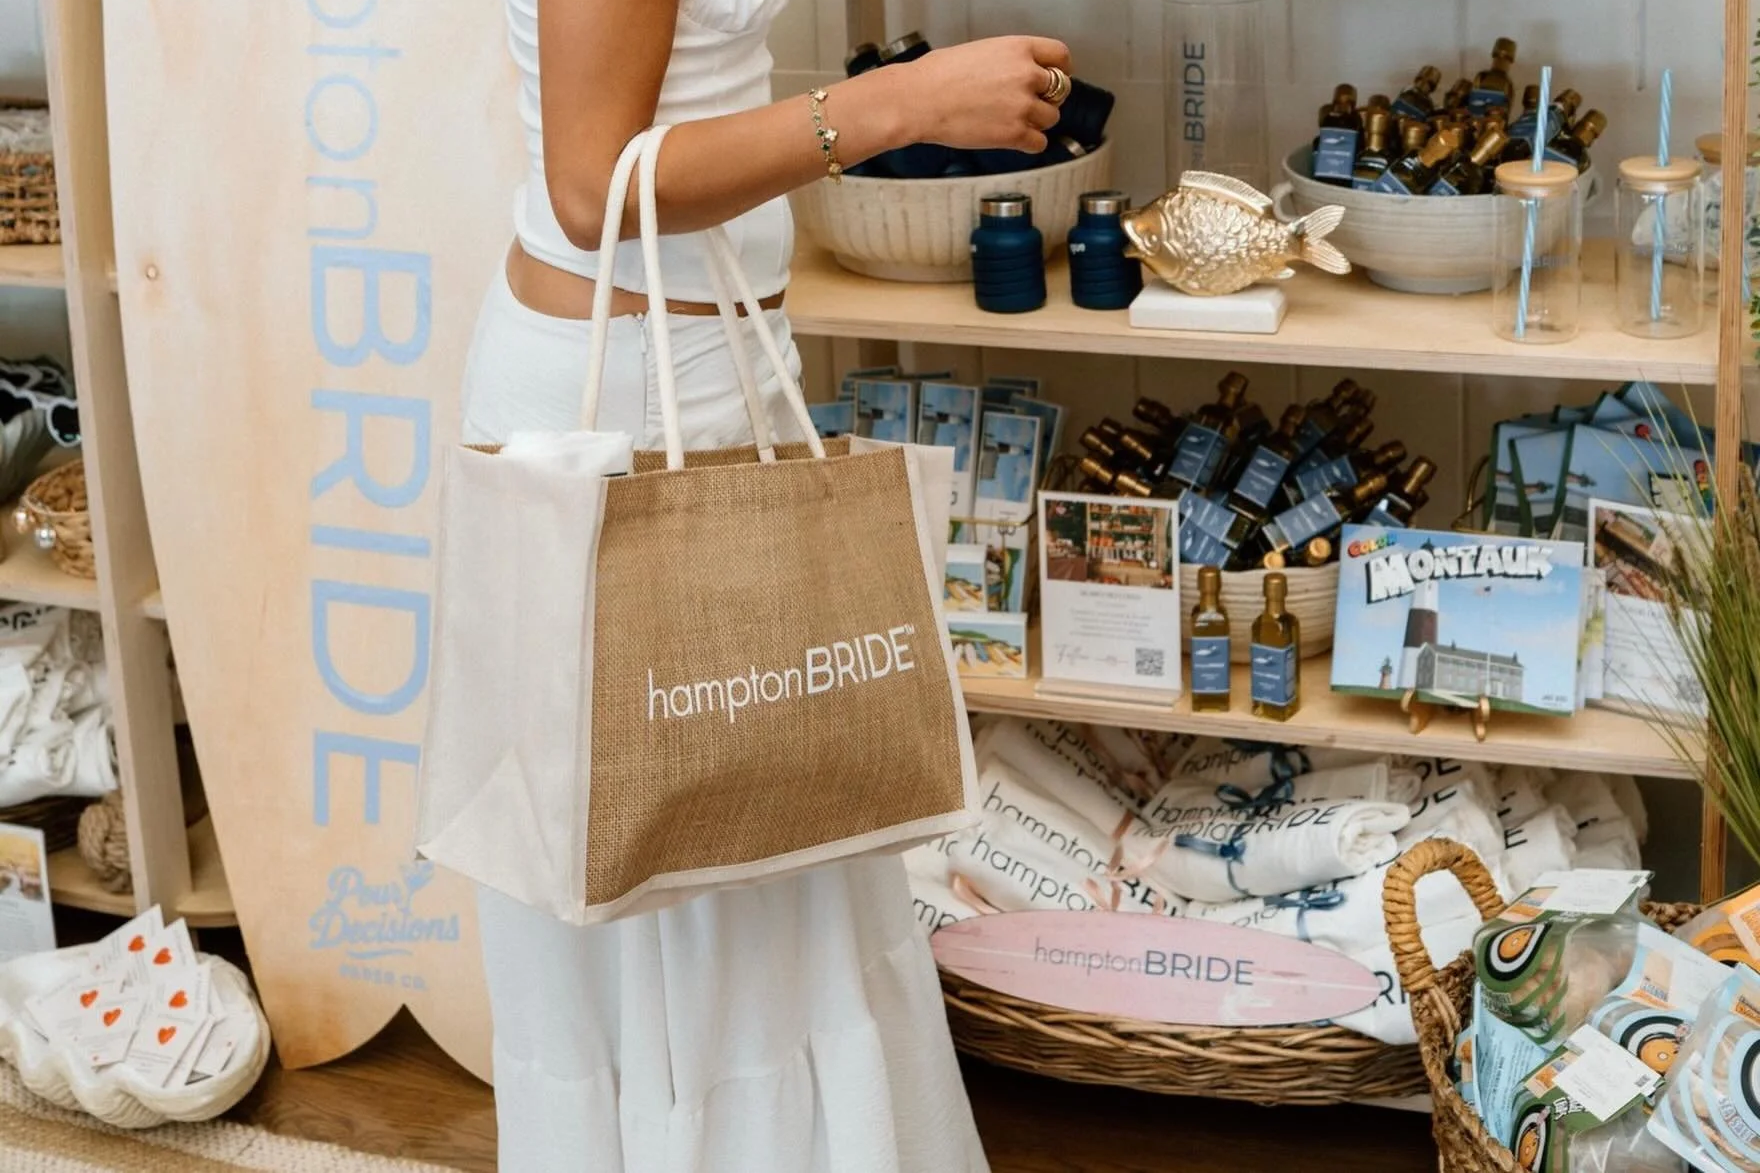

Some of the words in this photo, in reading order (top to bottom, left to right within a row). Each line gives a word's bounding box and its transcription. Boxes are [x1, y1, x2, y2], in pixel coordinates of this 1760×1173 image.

[1183, 41, 1206, 156] BRIDE
[1366, 544, 1553, 605] MONTAUK
[308, 902, 460, 949] Decisions
[1034, 937, 1255, 986] hamptonBRIDE
